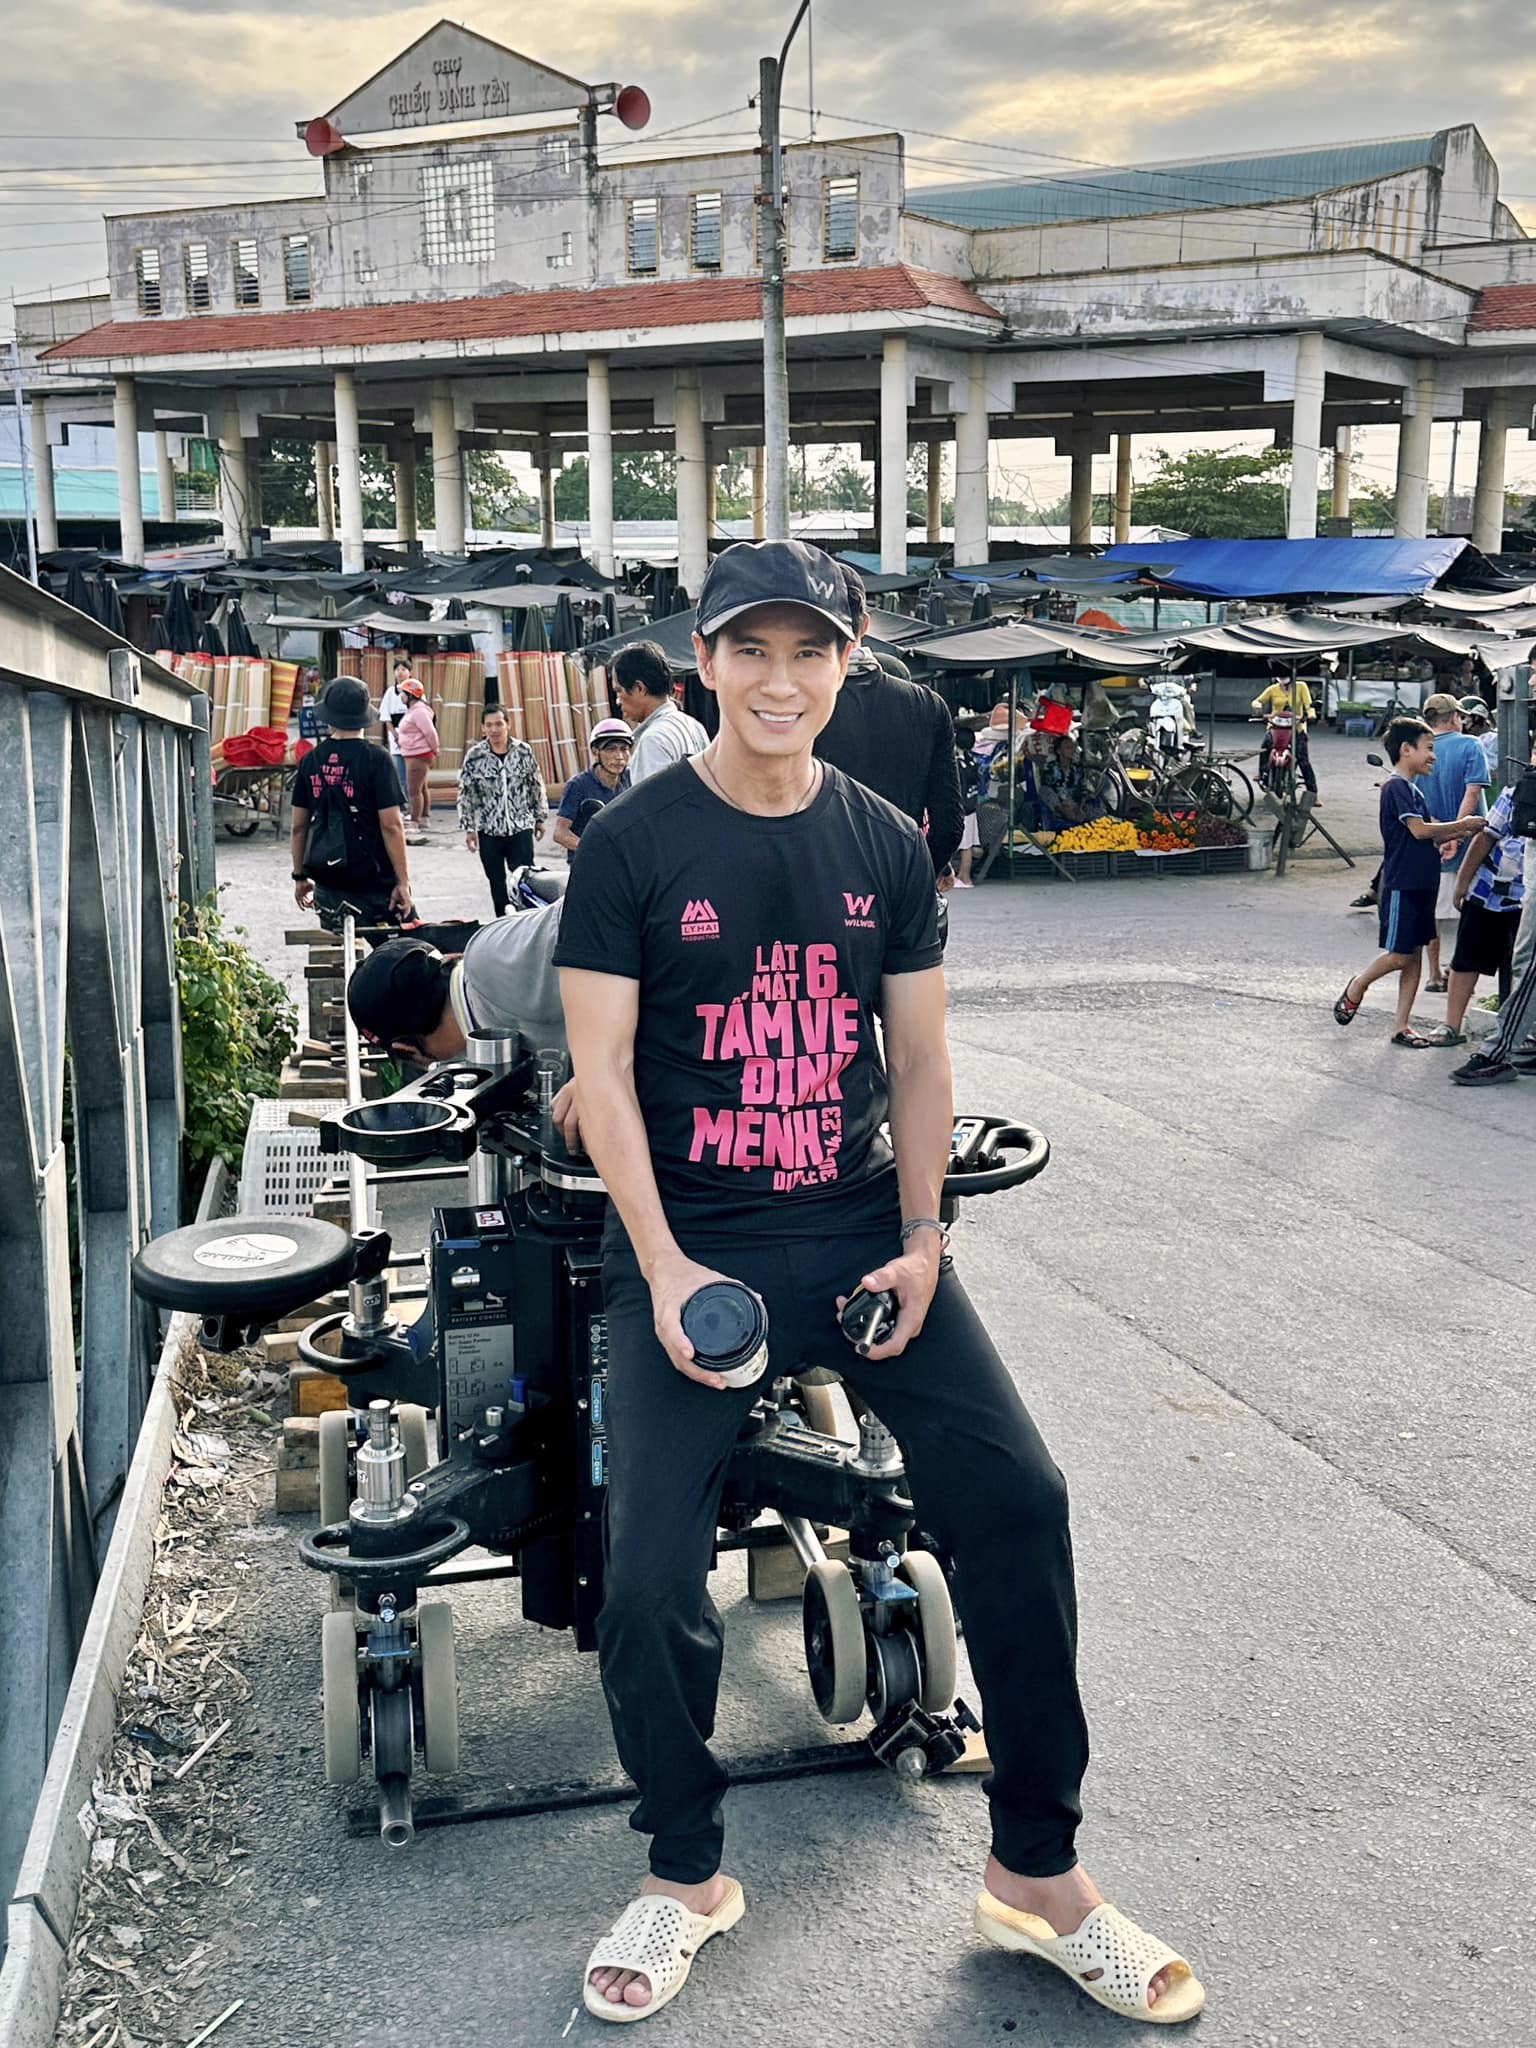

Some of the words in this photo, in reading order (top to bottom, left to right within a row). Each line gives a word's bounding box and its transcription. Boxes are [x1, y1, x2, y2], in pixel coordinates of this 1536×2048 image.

[389, 81, 431, 115] CHIẾU
[438, 84, 476, 115] ĐỊNH
[481, 76, 510, 105] YÊN
[805, 943, 838, 1000] 6
[695, 991, 796, 1062] TẤM
[796, 991, 860, 1055] VÉ
[688, 1106, 824, 1173] MỆNH
